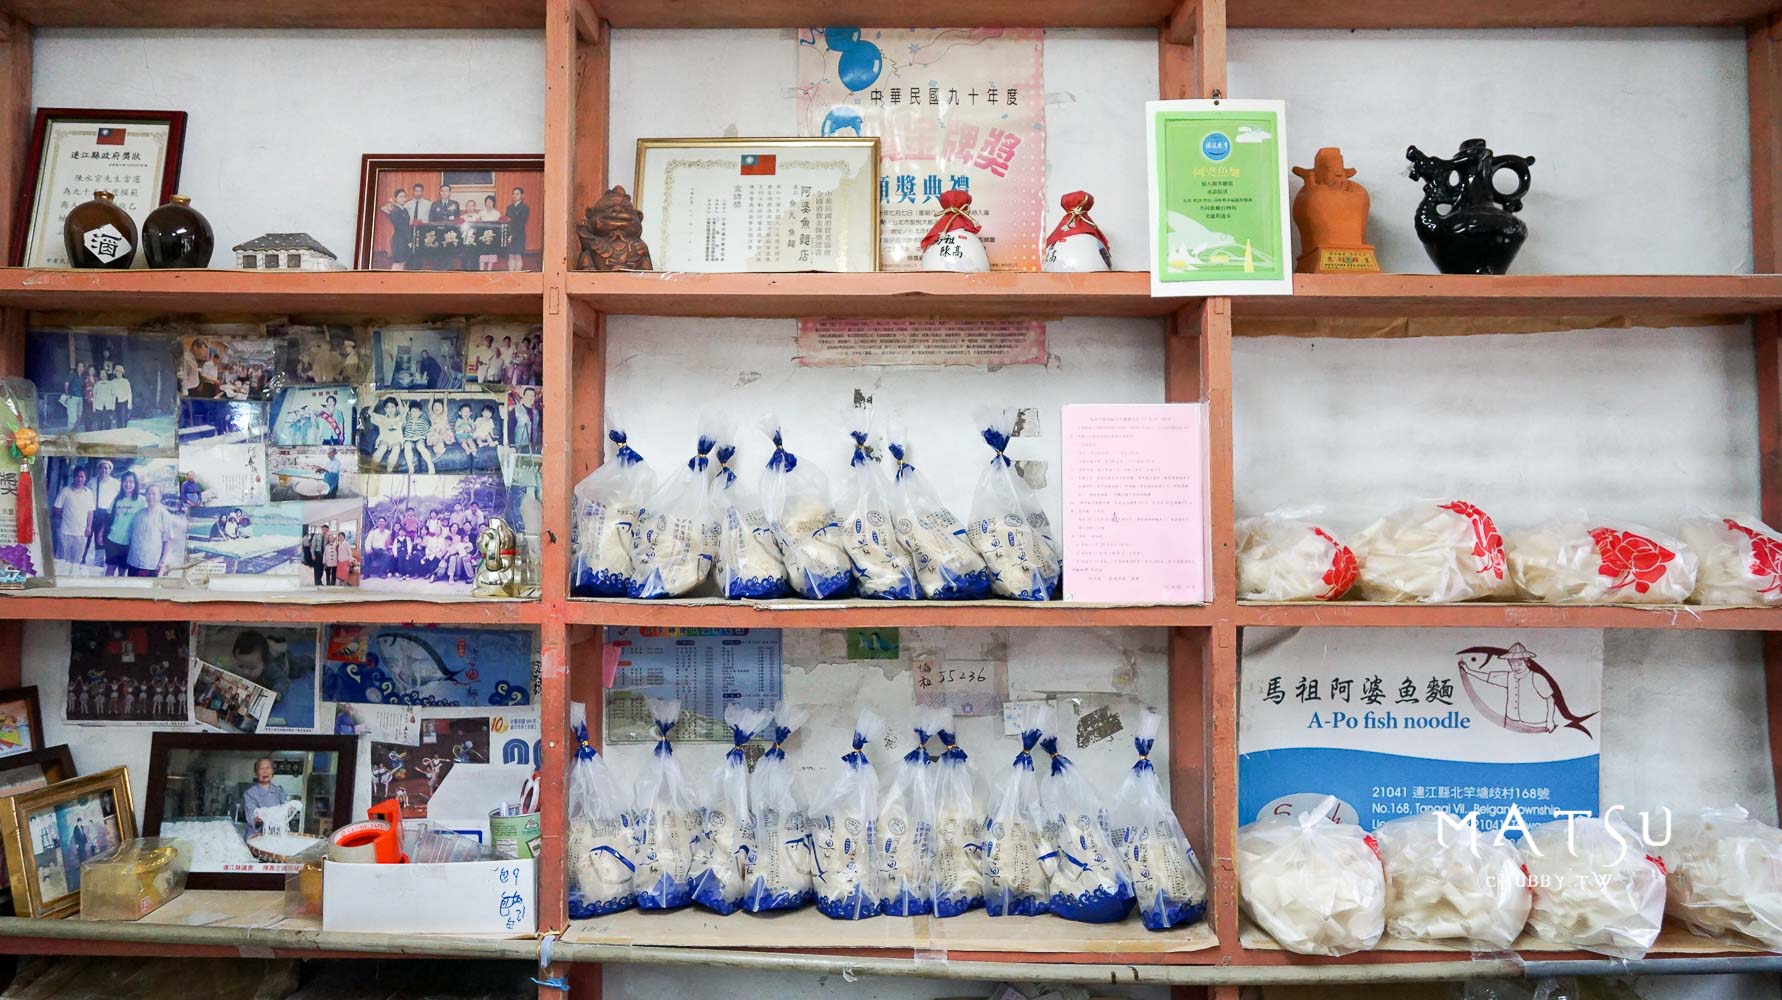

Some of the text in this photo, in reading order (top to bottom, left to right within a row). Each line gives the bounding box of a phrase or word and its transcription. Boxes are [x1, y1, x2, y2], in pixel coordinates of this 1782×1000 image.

[870, 87, 1018, 106] 中華民國九十年度
[71, 150, 141, 160] 連江縣政府獎狀
[798, 185, 812, 262] 阿婆魚麵店
[91, 233, 123, 258] 酒
[939, 245, 964, 259] 陳高
[938, 666, 987, 683] 55236
[1262, 674, 1455, 706] 馬祖阿婆魚麵
[1307, 711, 1471, 730] A-Po fish noodle
[1372, 786, 1408, 798] 21041
[1372, 802, 1413, 815] No.168,
